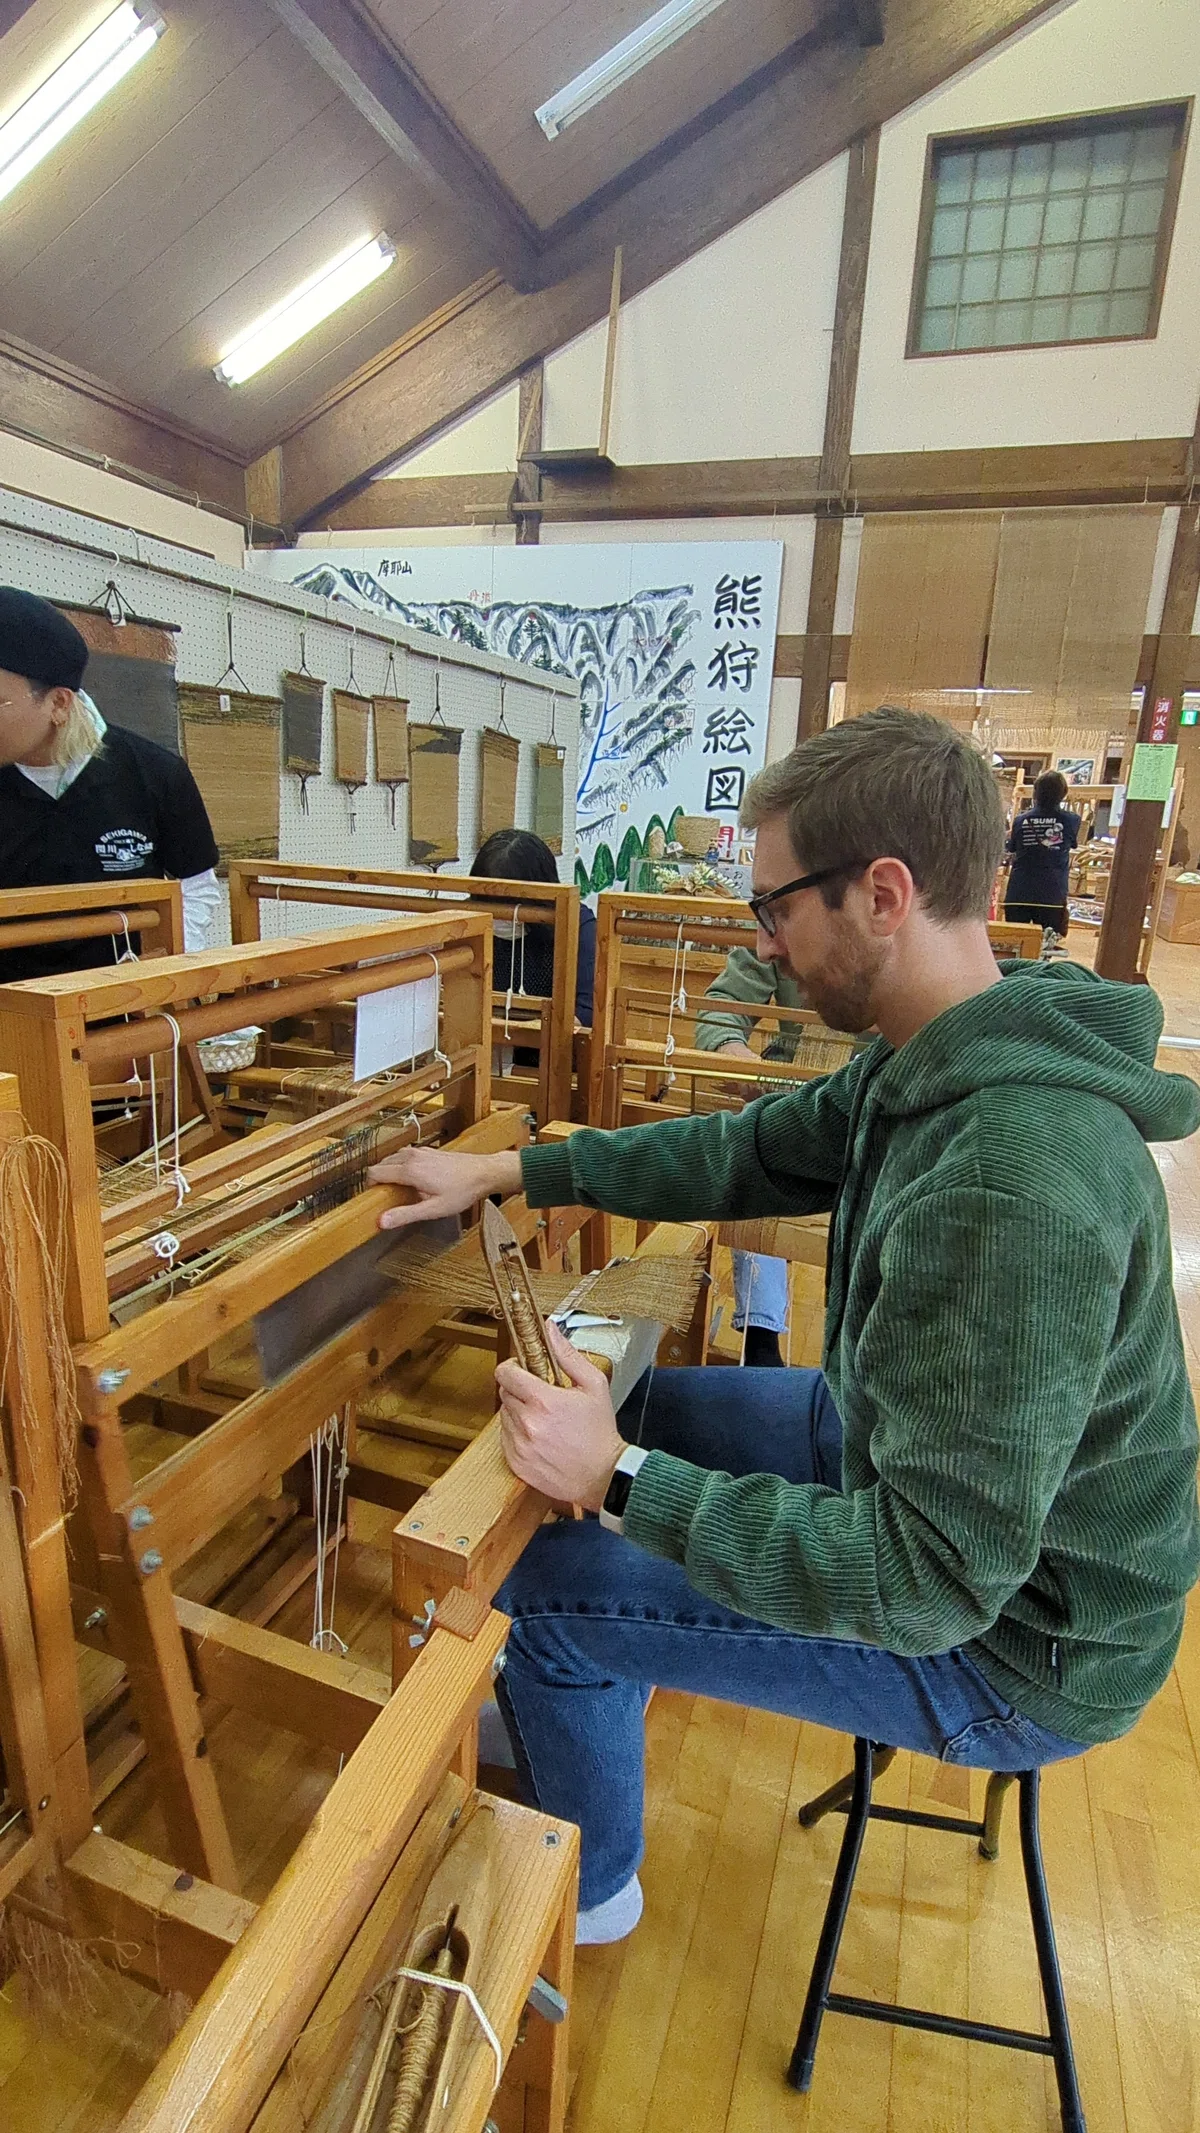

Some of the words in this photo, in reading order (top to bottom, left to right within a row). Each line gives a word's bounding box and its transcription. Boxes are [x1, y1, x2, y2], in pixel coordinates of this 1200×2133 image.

[378, 559, 413, 577] 摩耶山
[703, 574, 762, 811] 熊狩絵図
[1152, 701, 1170, 741] 消火器
[1022, 817, 1057, 825] ATSUMI
